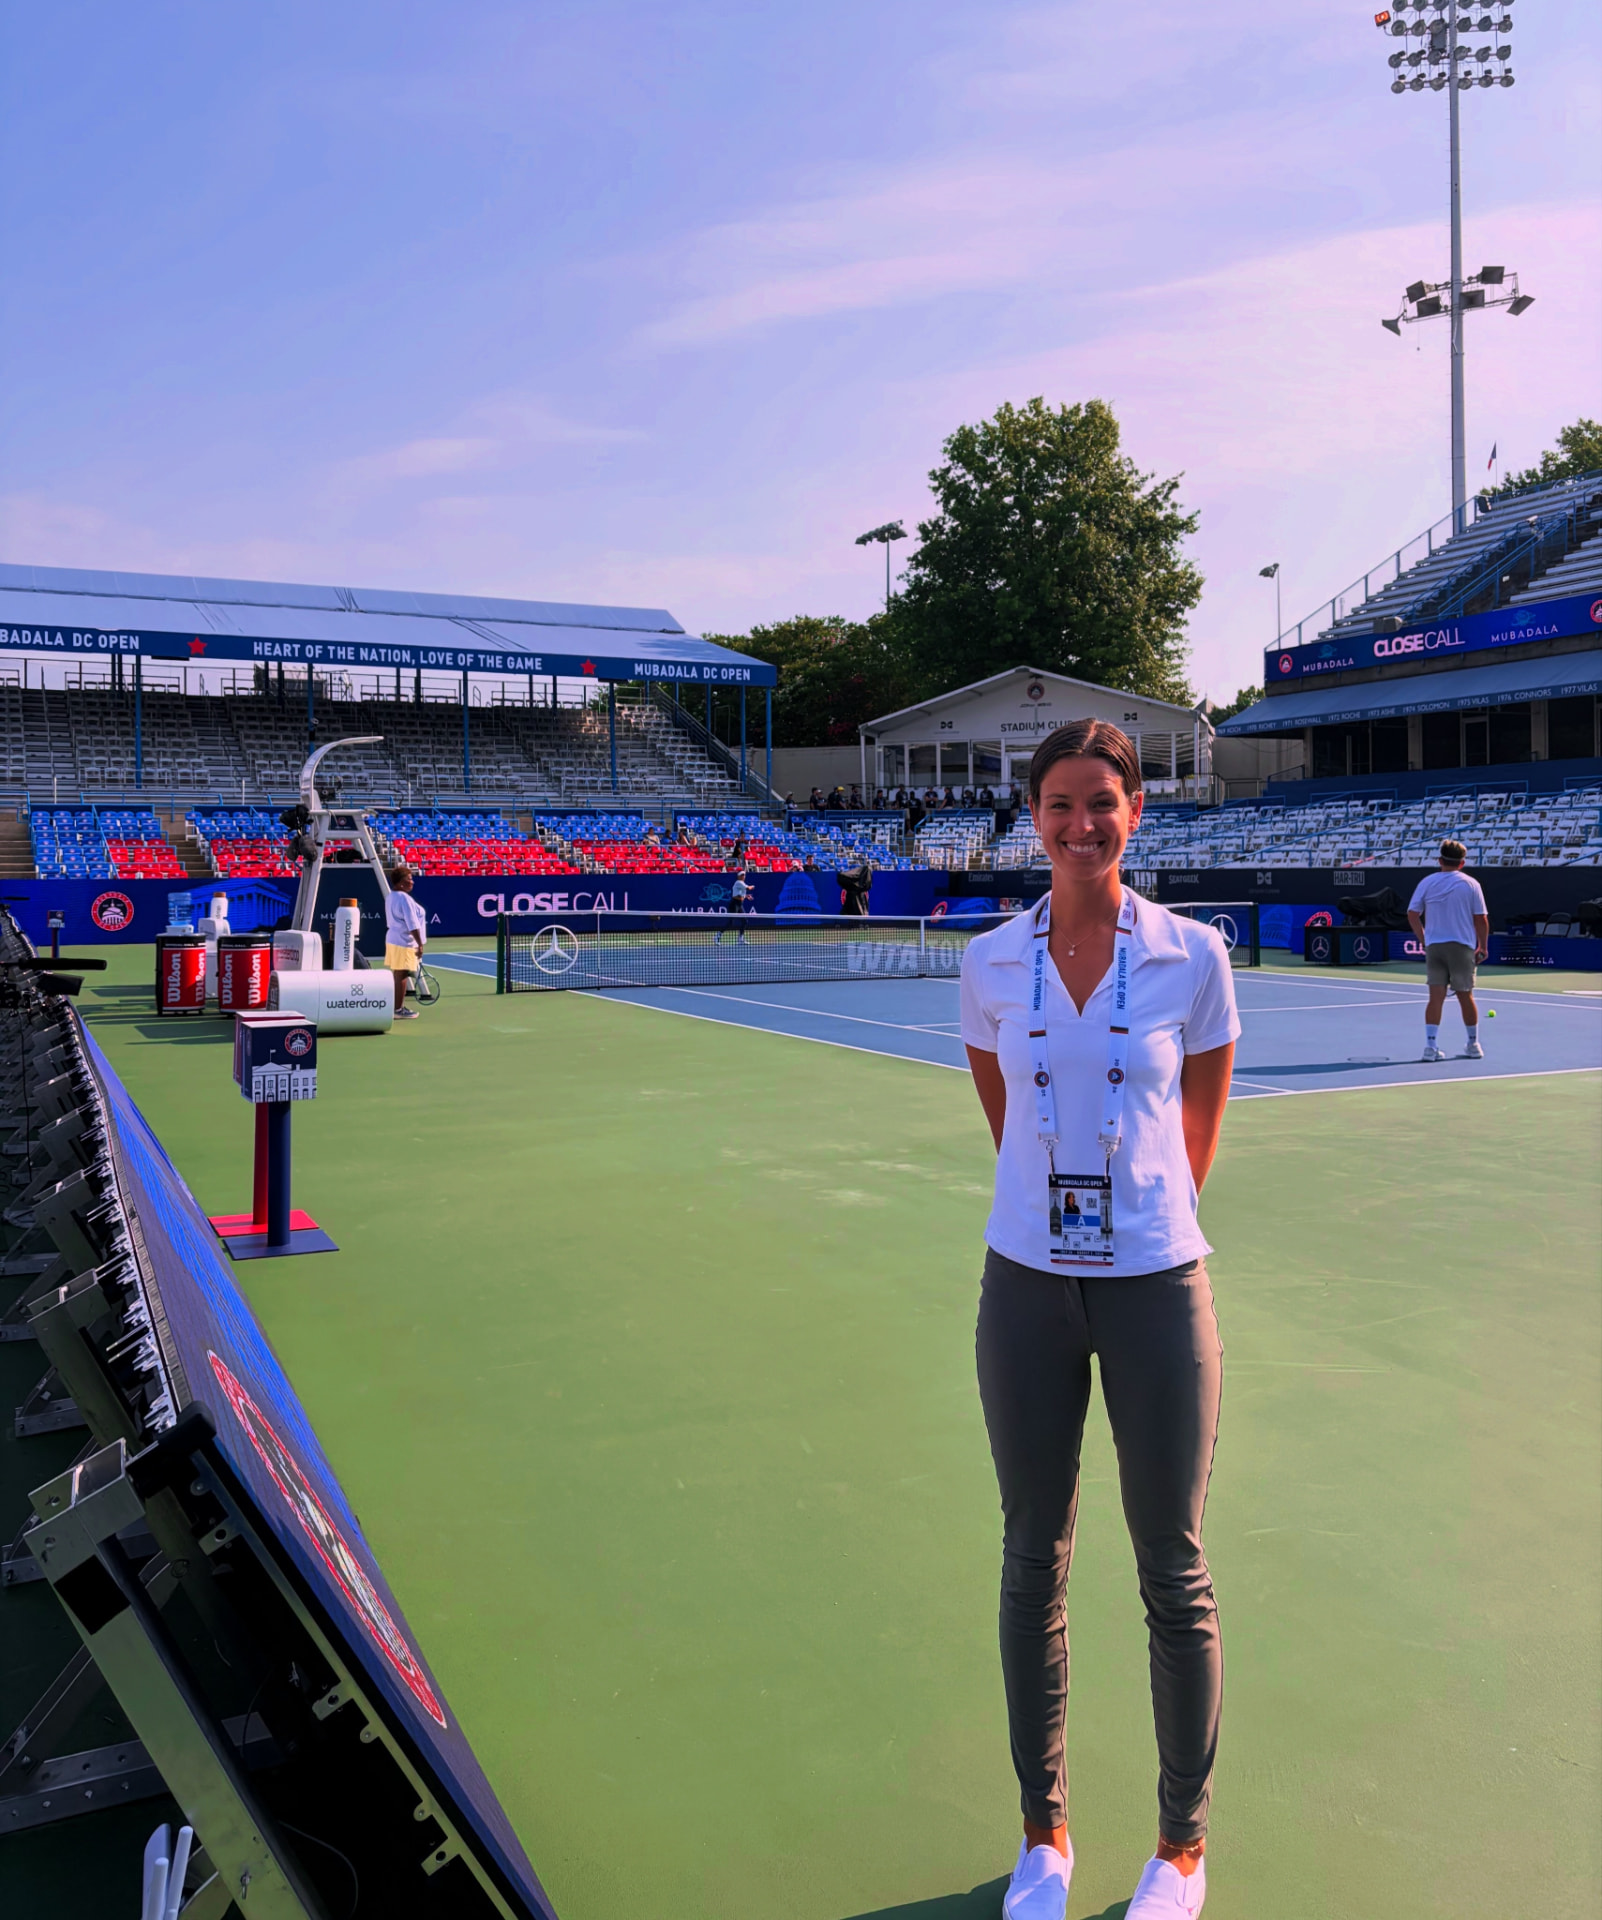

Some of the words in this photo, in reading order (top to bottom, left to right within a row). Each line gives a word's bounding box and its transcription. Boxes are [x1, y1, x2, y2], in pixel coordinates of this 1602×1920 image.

[73, 632, 93, 648] DC
[98, 634, 140, 650] OPEN
[1491, 624, 1558, 643] MUBADALA
[253, 641, 301, 657] HEART
[305, 644, 323, 659] OF
[328, 645, 355, 660] THE
[360, 647, 416, 665] NATION,
[420, 650, 454, 666] LOVE
[458, 652, 474, 667] OF
[478, 654, 503, 668] THE
[507, 656, 543, 670] GAME
[1303, 657, 1355, 672] MUBADALA
[634, 663, 698, 678] MUBADALA
[703, 666, 718, 679] DC
[721, 668, 751, 681] OPEN
[1417, 701, 1450, 712] SOLOMON
[1472, 696, 1490, 705] VILAS
[1497, 694, 1512, 702] 1976
[1514, 689, 1552, 701] CONNORS
[1560, 685, 1576, 695] 1977
[1578, 682, 1598, 692] VILAS
[1000, 721, 1045, 732] STADIUM
[1168, 873, 1199, 884] SEATGEEK
[1334, 871, 1365, 885] HAR-TRU
[343, 919, 352, 962] waterdrop
[1035, 949, 1044, 966] OPEN
[1117, 947, 1127, 979] MUBADALA
[167, 952, 181, 1003] Wilson
[195, 952, 205, 1003] Wilson
[222, 953, 233, 1005] Wilson
[248, 953, 261, 1005] Wilson
[1035, 966, 1043, 976] DC
[1033, 976, 1042, 1011] MUBADALA
[1117, 979, 1127, 990] DC
[326, 998, 387, 1010] waterdrop
[1116, 991, 1126, 1010] OPEN
[1078, 1216, 1086, 1226] A
